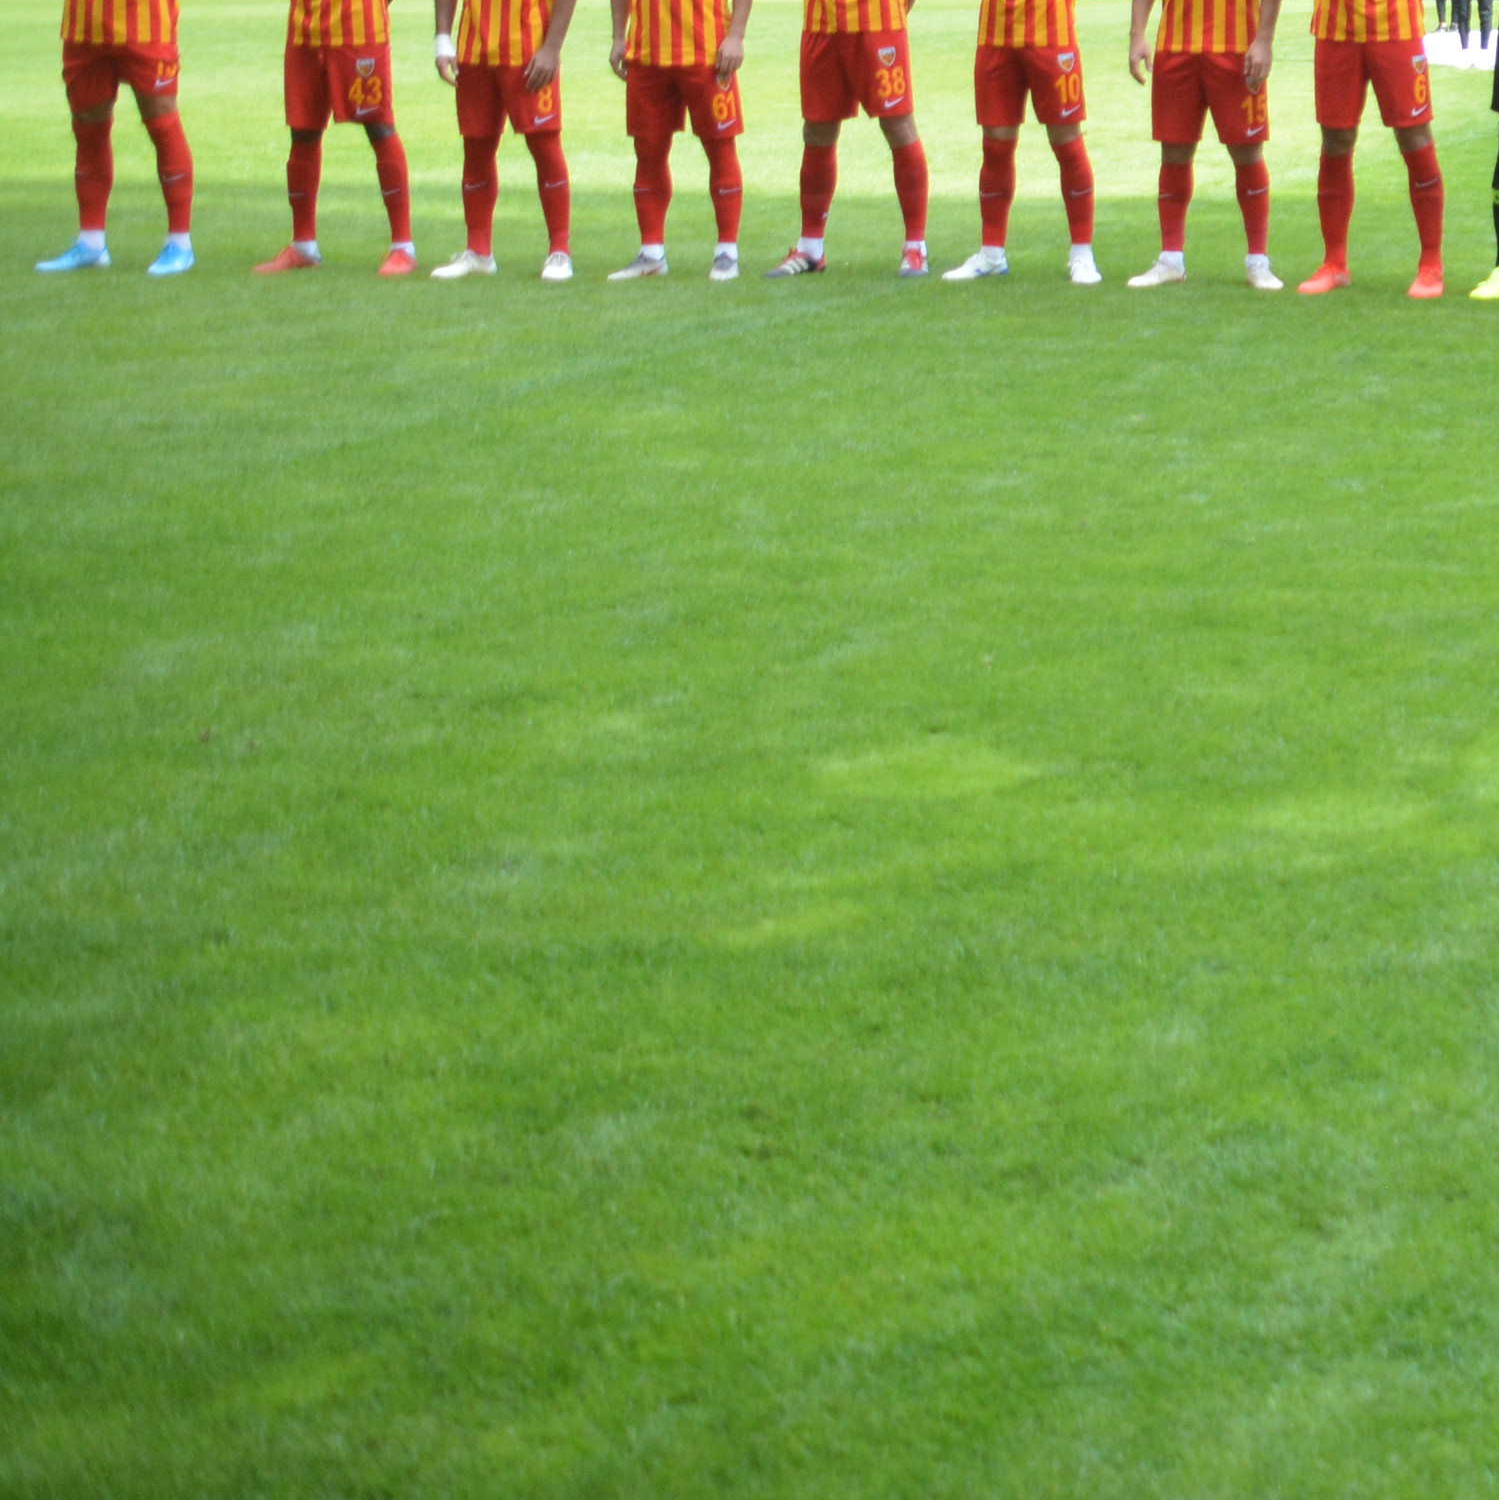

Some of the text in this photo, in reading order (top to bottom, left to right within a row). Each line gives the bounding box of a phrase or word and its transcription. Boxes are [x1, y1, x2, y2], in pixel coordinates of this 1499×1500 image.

[348, 76, 383, 105] 43
[875, 66, 906, 99] 38
[1055, 72, 1081, 104] 10
[1414, 73, 1427, 105] 6
[712, 90, 737, 122] 61
[1242, 93, 1267, 126] 15
